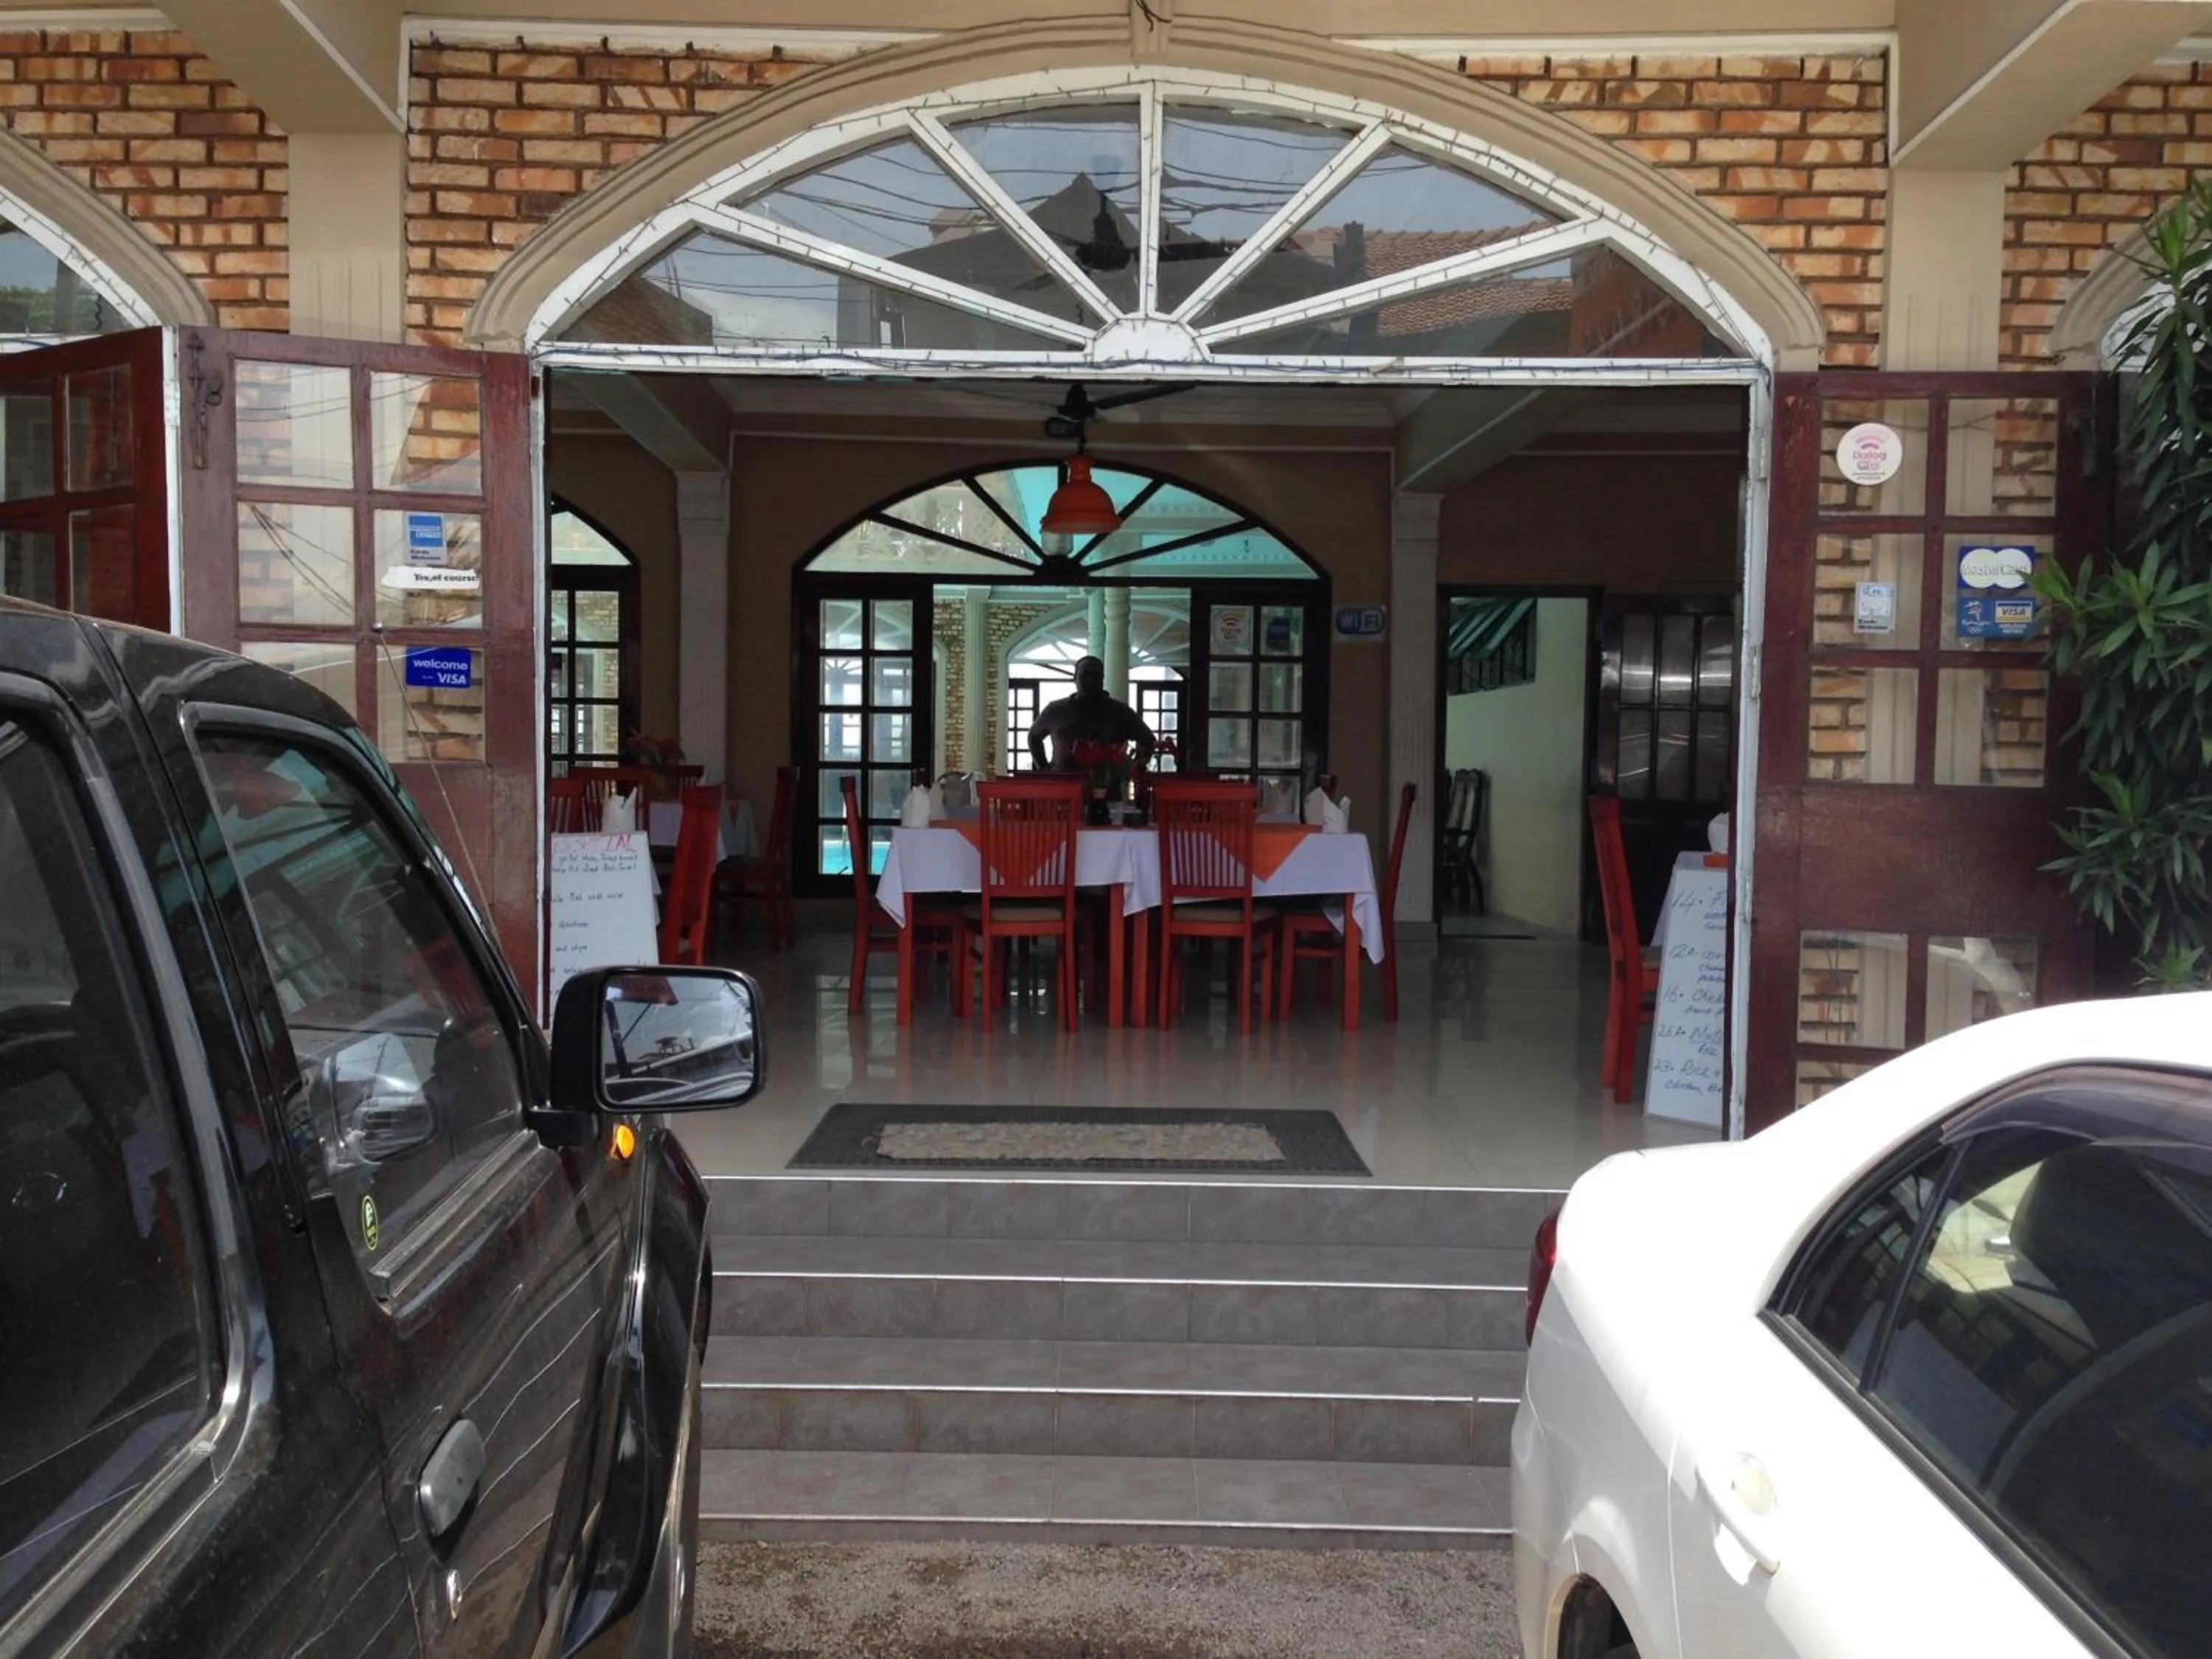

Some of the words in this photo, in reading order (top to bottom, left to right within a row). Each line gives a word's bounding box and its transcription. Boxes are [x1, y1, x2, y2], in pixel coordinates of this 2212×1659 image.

[2001, 608, 2027, 616] VISA
[413, 658, 469, 670] welcome
[437, 672, 467, 685] VISA
